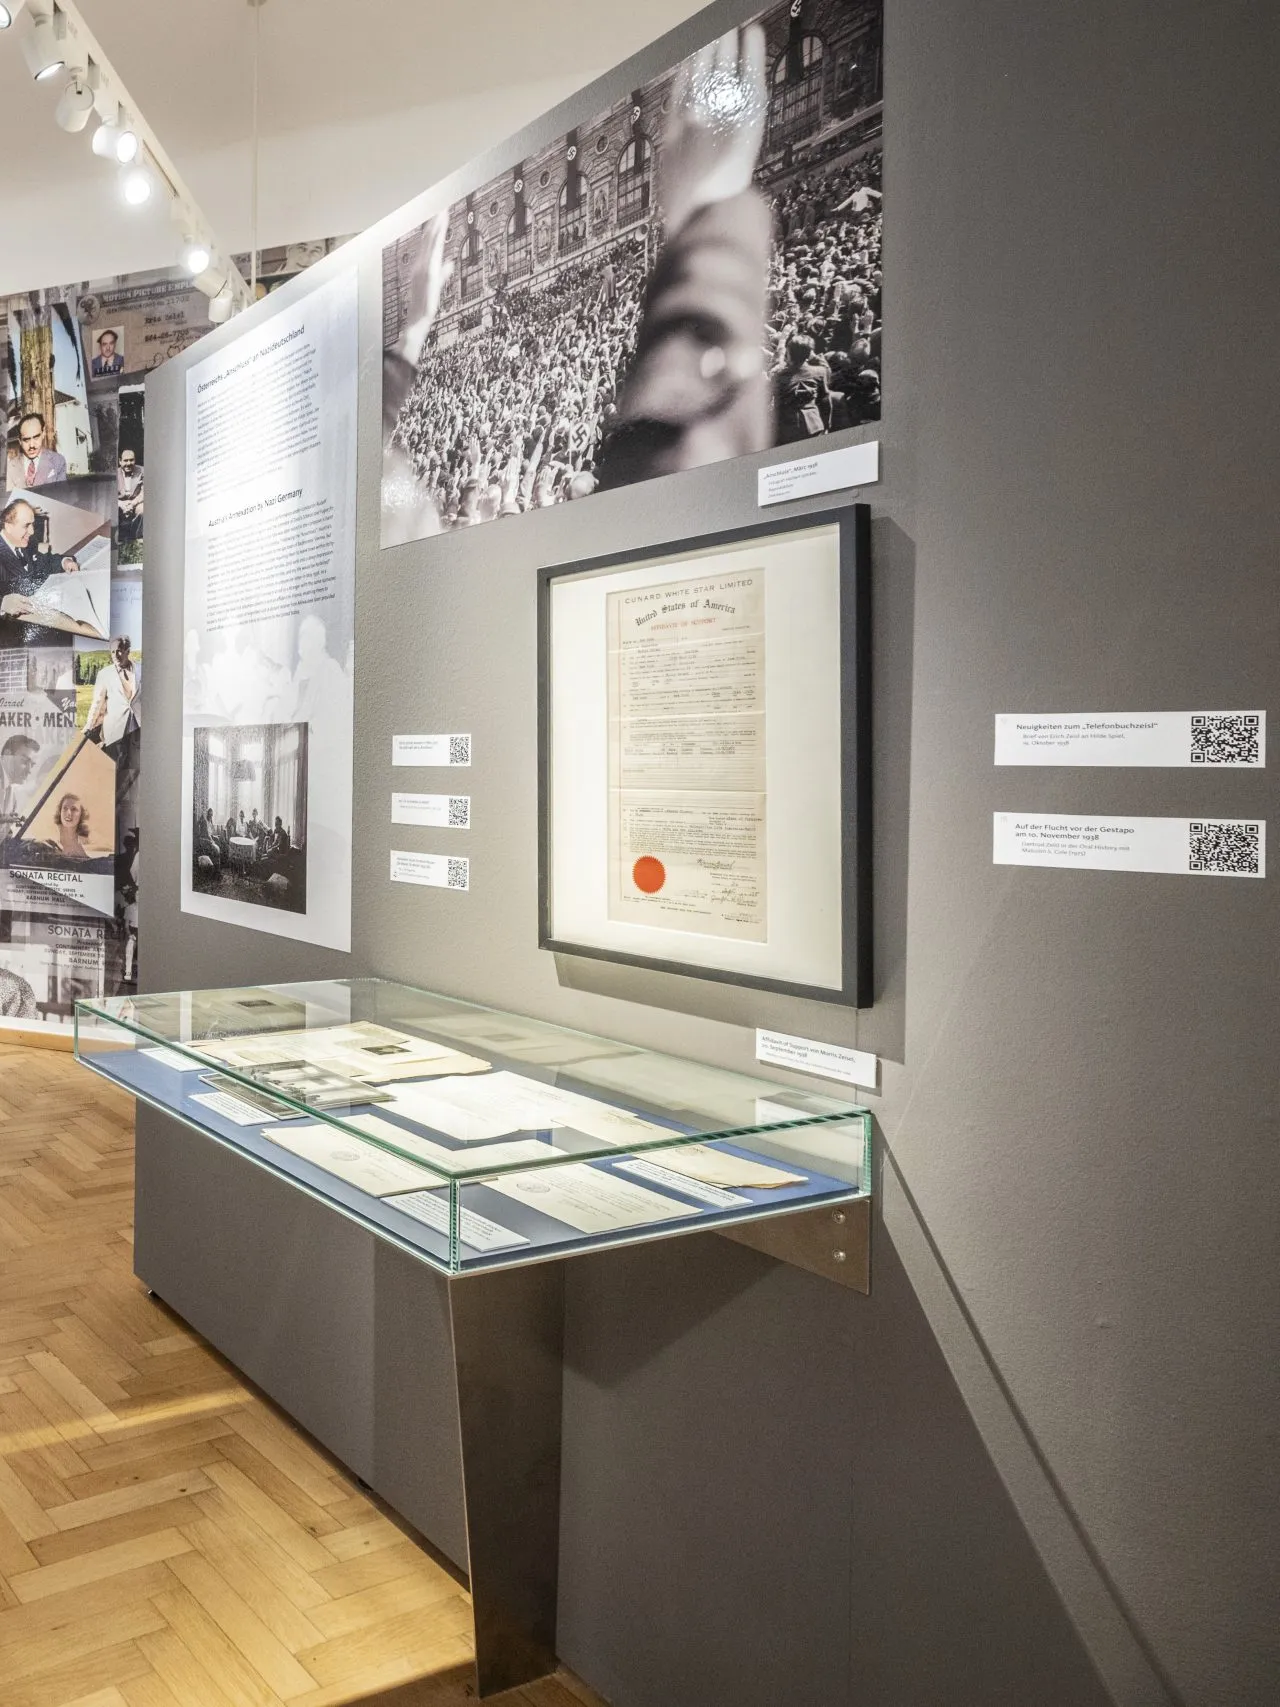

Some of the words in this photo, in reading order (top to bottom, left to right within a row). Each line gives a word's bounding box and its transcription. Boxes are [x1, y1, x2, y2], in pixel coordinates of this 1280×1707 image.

[264, 495, 277, 507] Nazi
[277, 487, 303, 503] Germany
[625, 593, 660, 604] CUNARD
[665, 589, 690, 598] WHITE
[694, 585, 715, 593] STAR
[720, 579, 752, 590] LIMITED
[635, 610, 658, 626] United
[662, 602, 686, 613] States
[690, 600, 700, 608] of
[703, 599, 735, 614] America
[0, 698, 24, 707] Israel
[10, 871, 44, 880] SONATA
[47, 873, 83, 882] RECITAL
[48, 925, 91, 938] SONATA
[769, 1044, 796, 1055] September
[789, 1042, 809, 1052] Support
